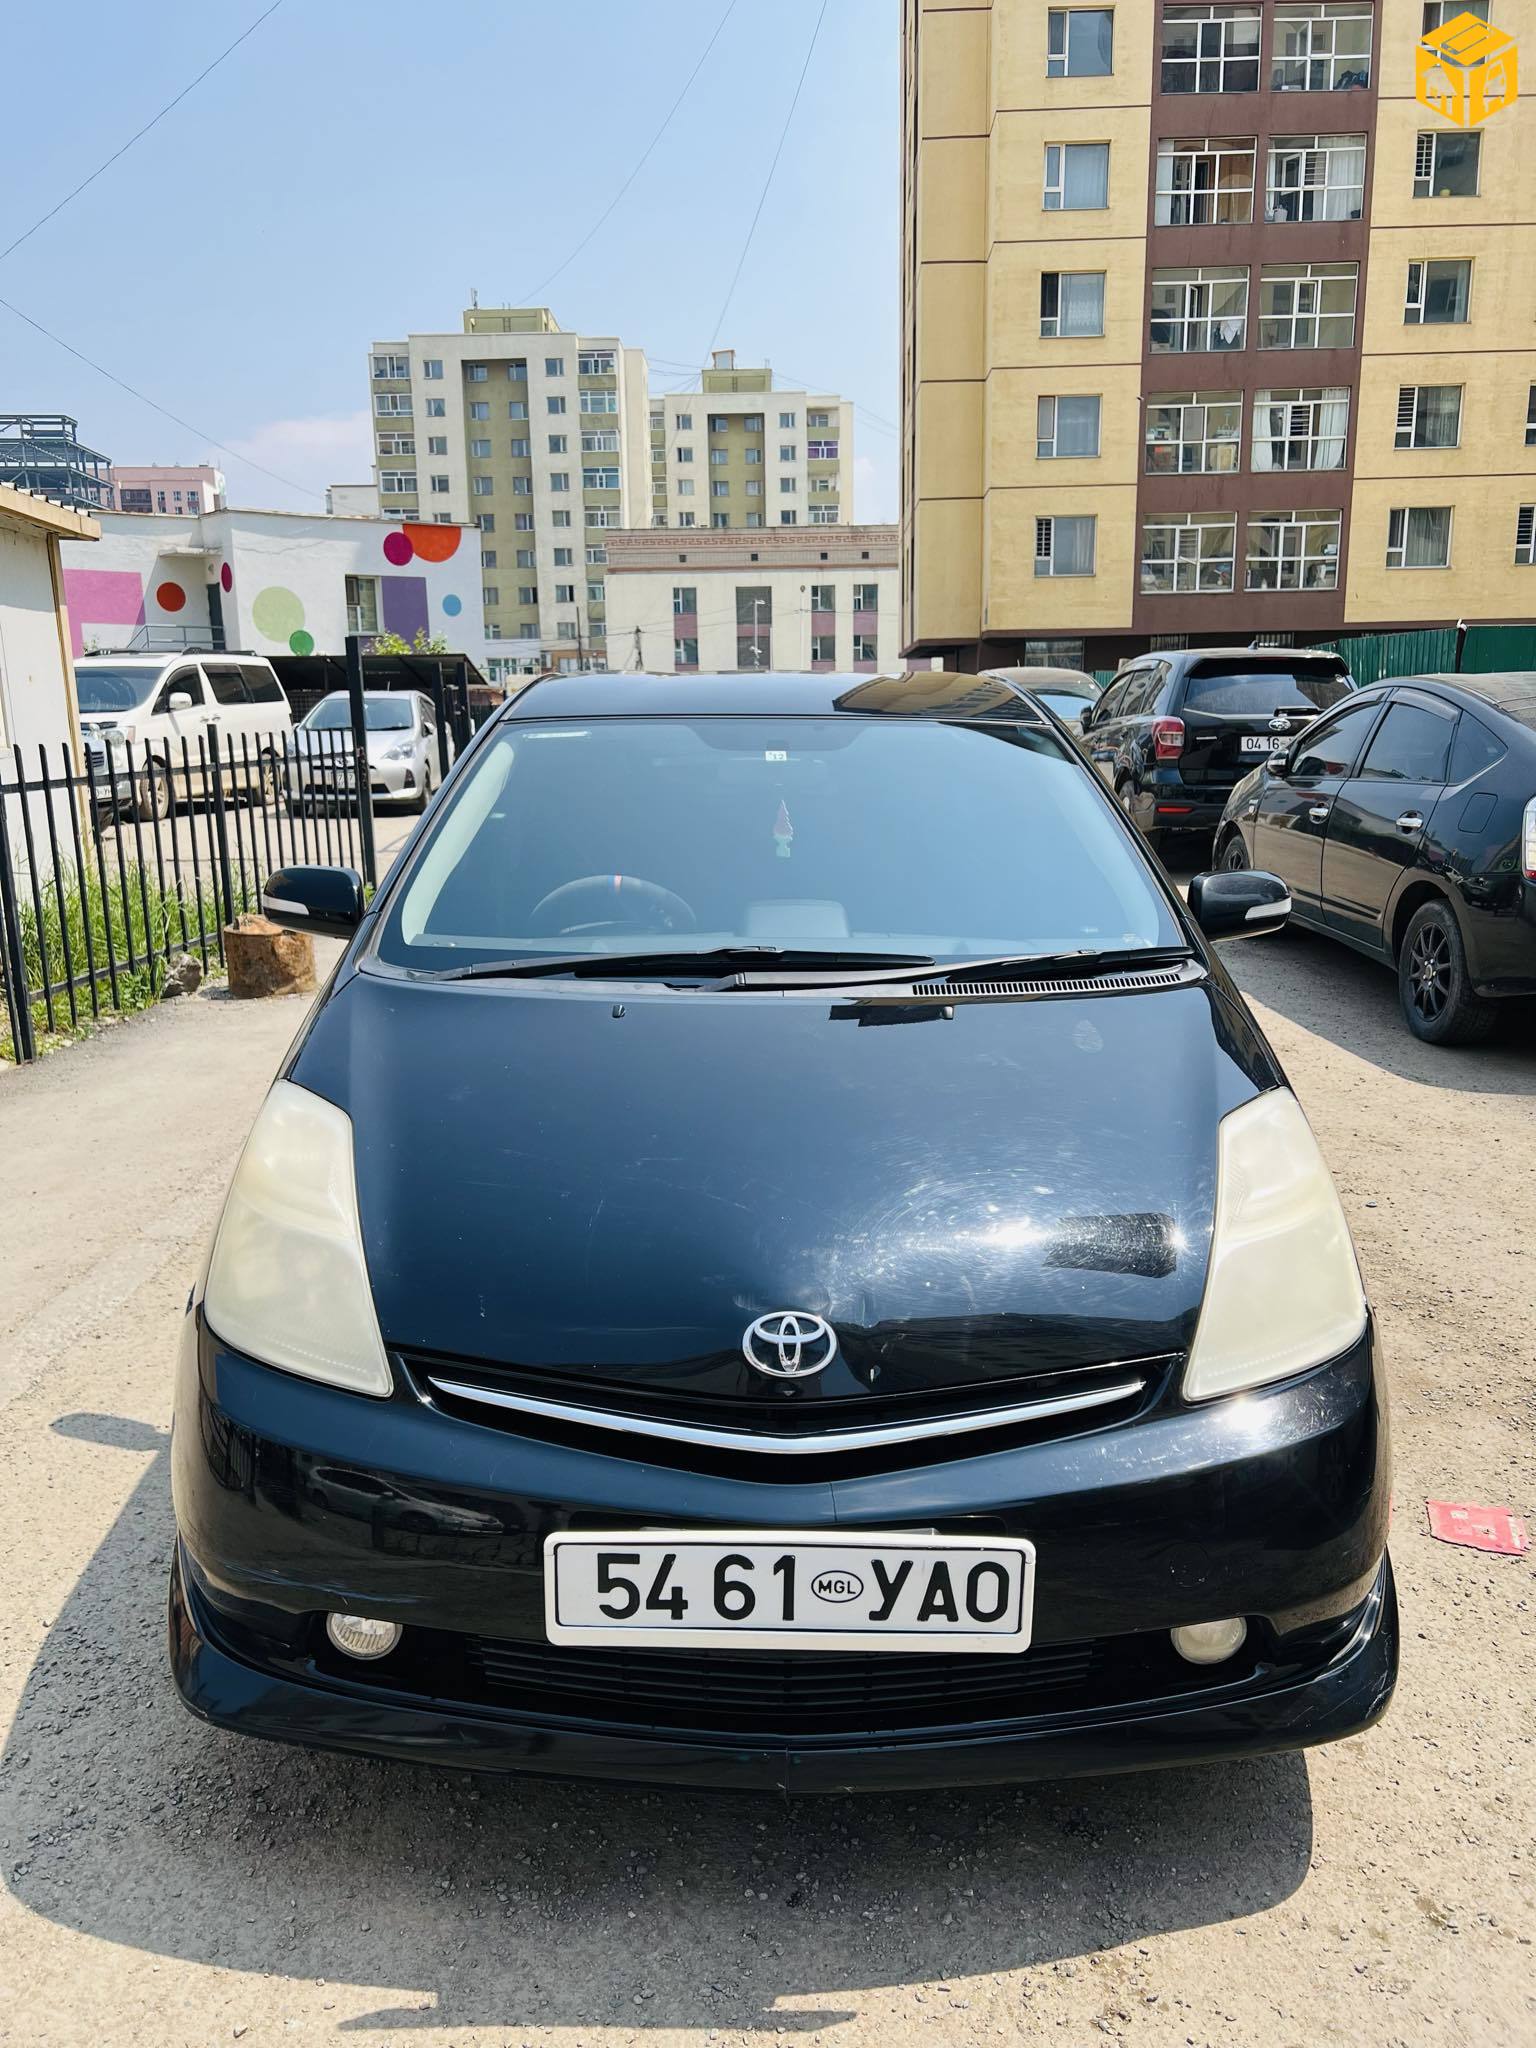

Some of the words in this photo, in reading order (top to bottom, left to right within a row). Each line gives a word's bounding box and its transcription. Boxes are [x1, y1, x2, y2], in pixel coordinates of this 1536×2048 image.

[1246, 737, 1261, 750] 04
[1266, 737, 1280, 750] 16
[817, 1579, 857, 1597] MGL
